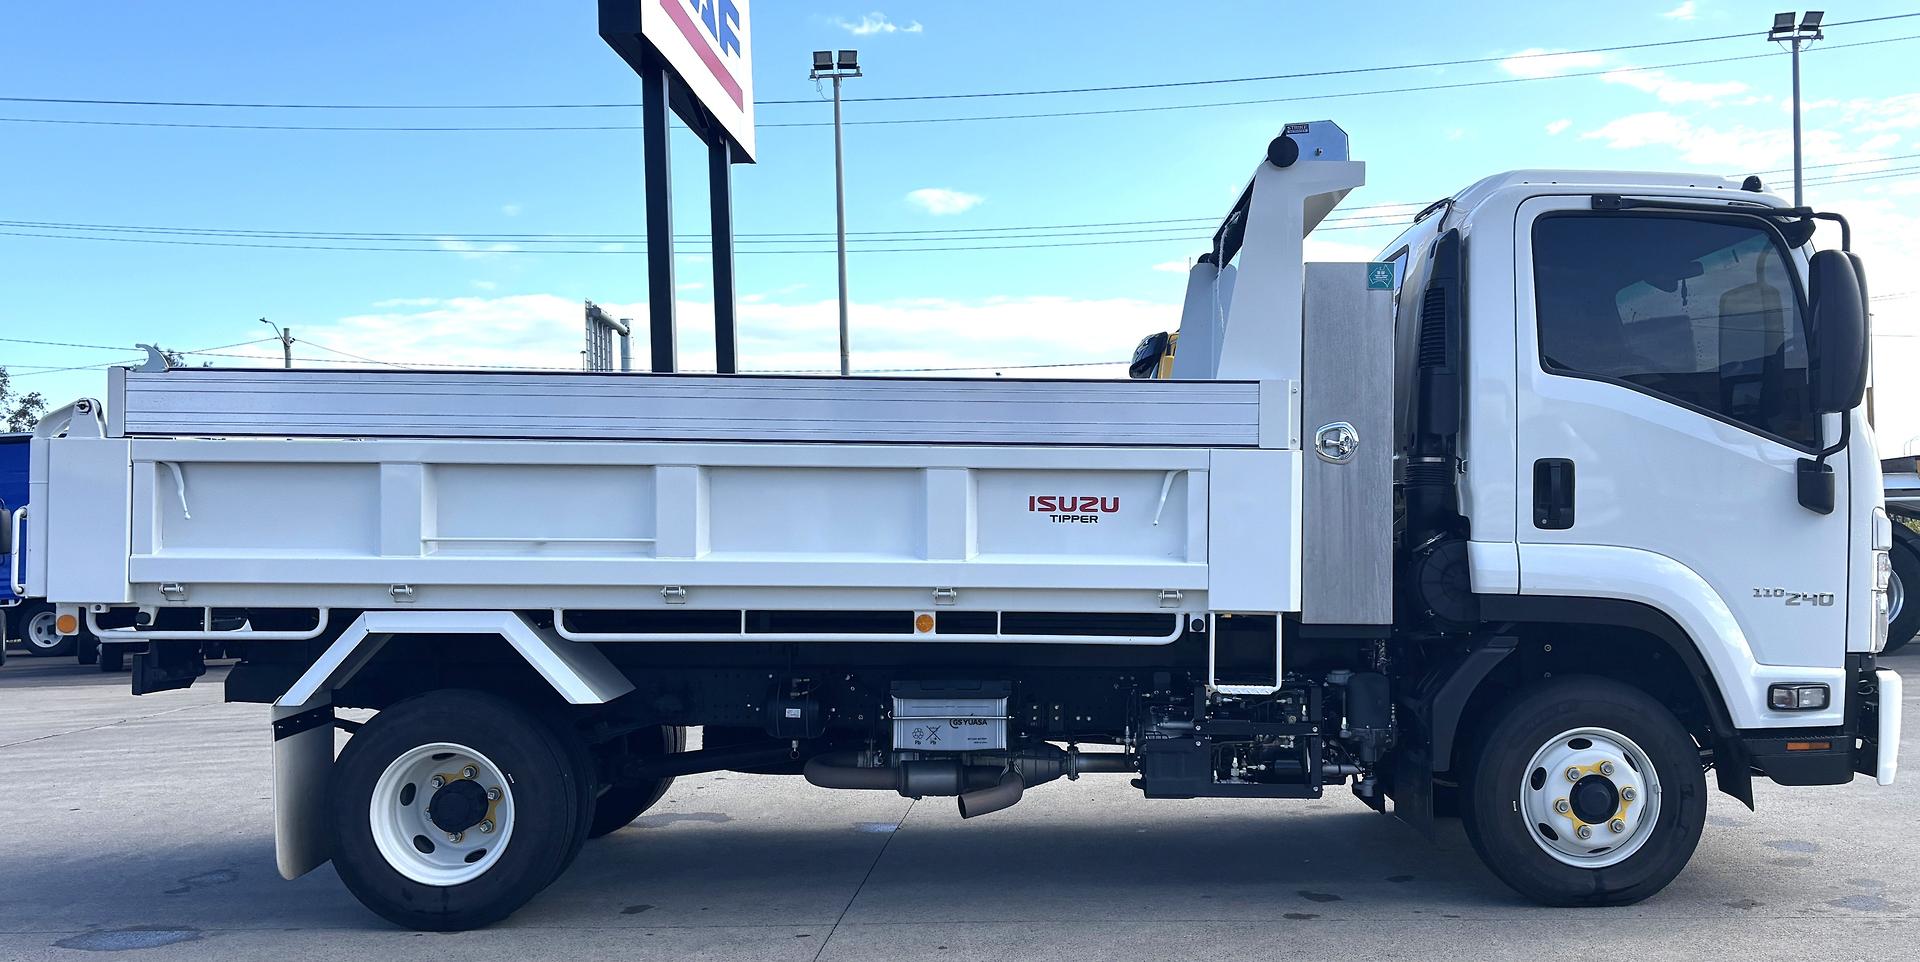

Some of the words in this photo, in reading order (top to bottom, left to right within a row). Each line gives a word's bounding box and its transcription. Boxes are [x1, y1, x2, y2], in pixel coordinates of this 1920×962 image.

[1028, 495, 1120, 513] ISUZU
[1049, 514, 1099, 524] TIPPER
[1753, 588, 1785, 598] 110
[1785, 592, 1834, 607] 240
